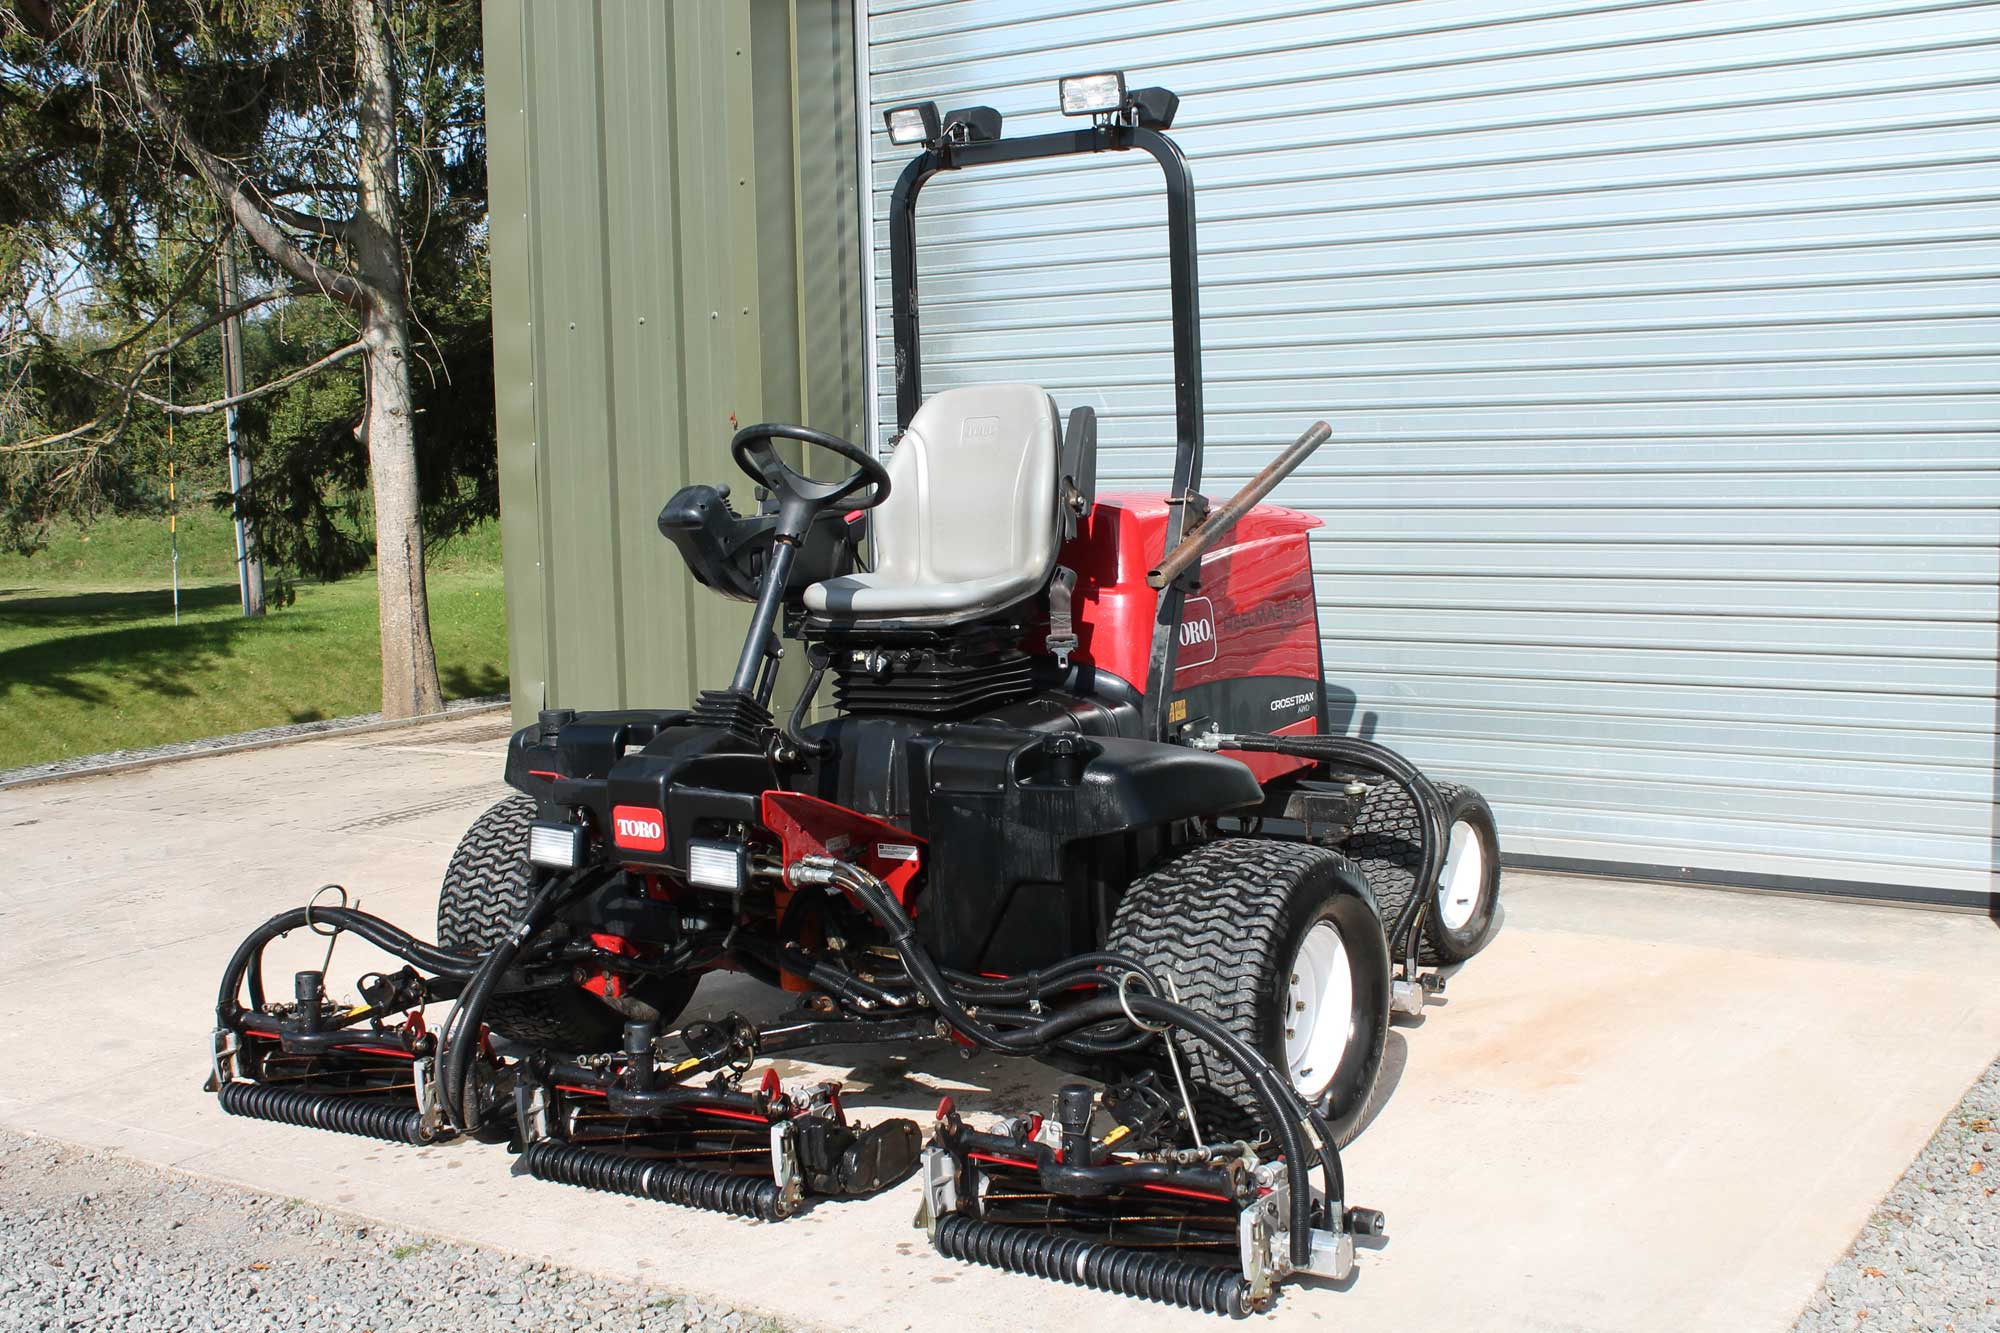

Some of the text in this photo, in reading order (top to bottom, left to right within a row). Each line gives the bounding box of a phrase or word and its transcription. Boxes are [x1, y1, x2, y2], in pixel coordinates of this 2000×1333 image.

[1179, 618, 1211, 646] ORO
[1271, 692, 1314, 711] CROSSTRAX
[1297, 704, 1310, 714] AWD
[617, 818, 661, 839] TORO
